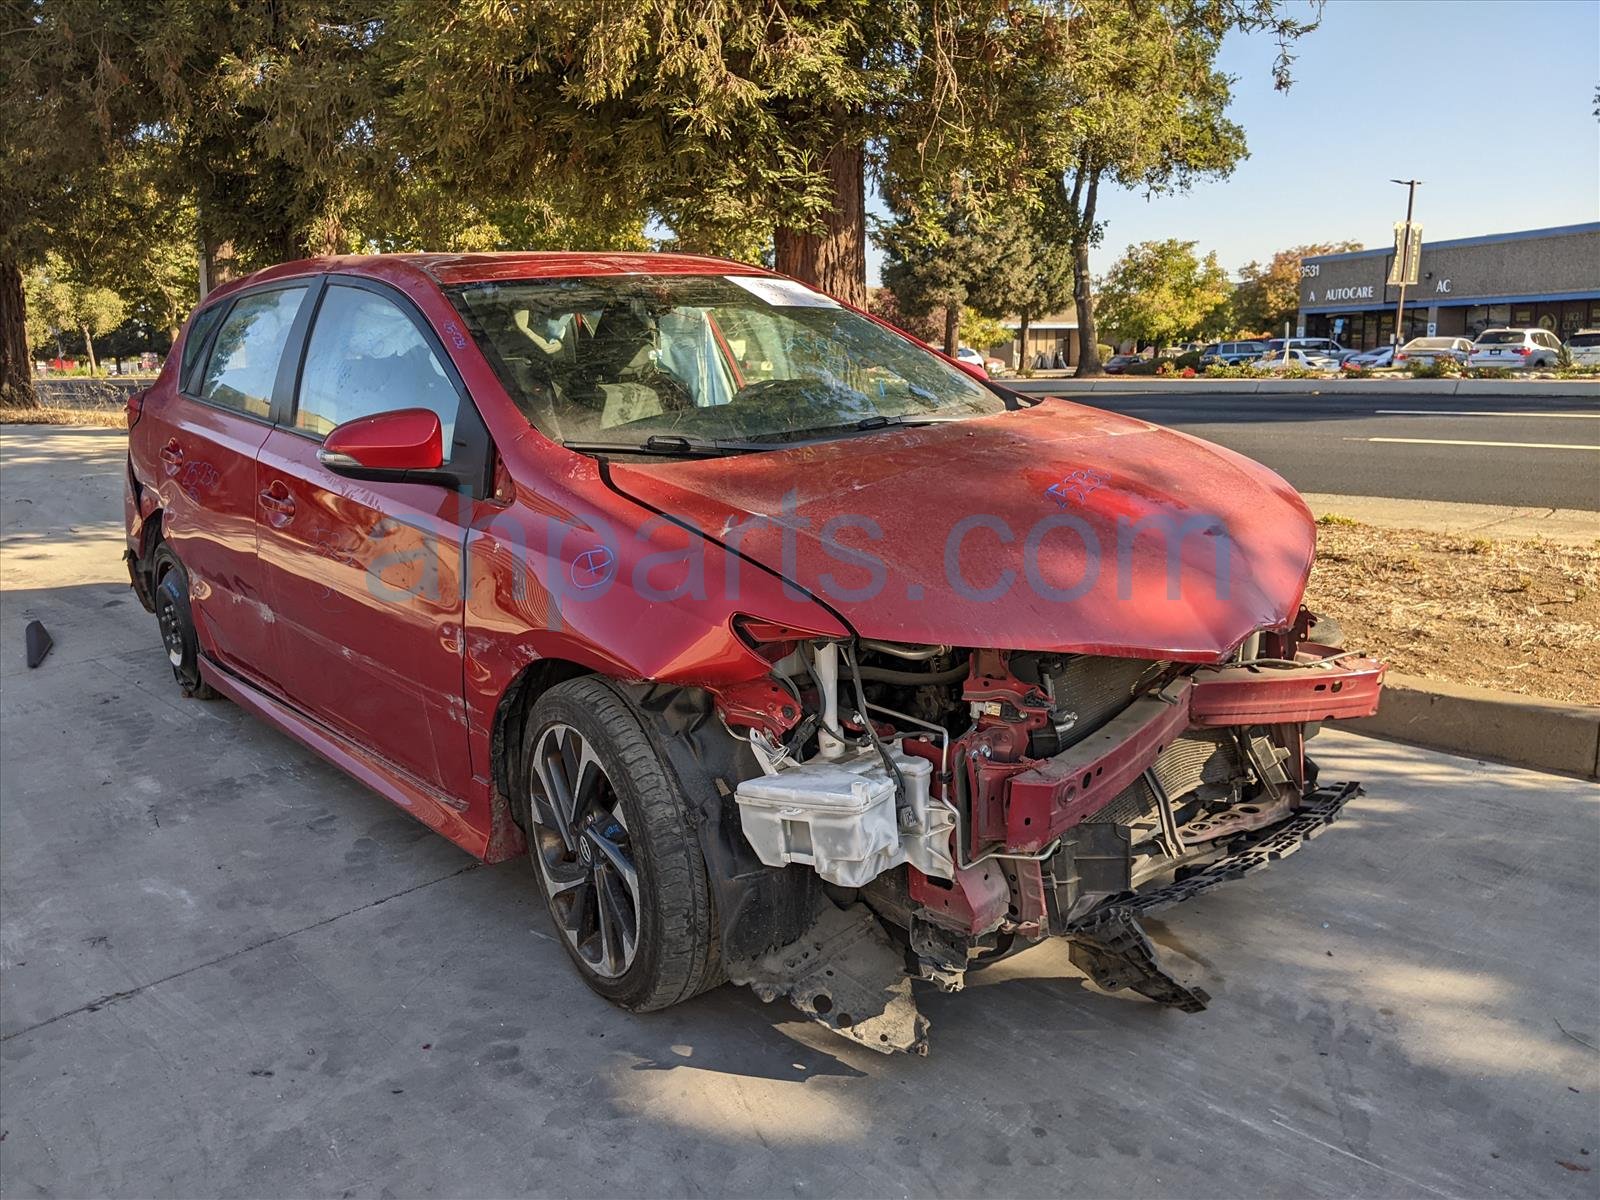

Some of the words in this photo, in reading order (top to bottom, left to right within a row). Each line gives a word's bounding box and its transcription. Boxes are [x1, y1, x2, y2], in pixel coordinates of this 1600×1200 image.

[1435, 279, 1451, 293] AC
[1308, 290, 1316, 302] A
[1325, 286, 1374, 301] AUTOCARE
